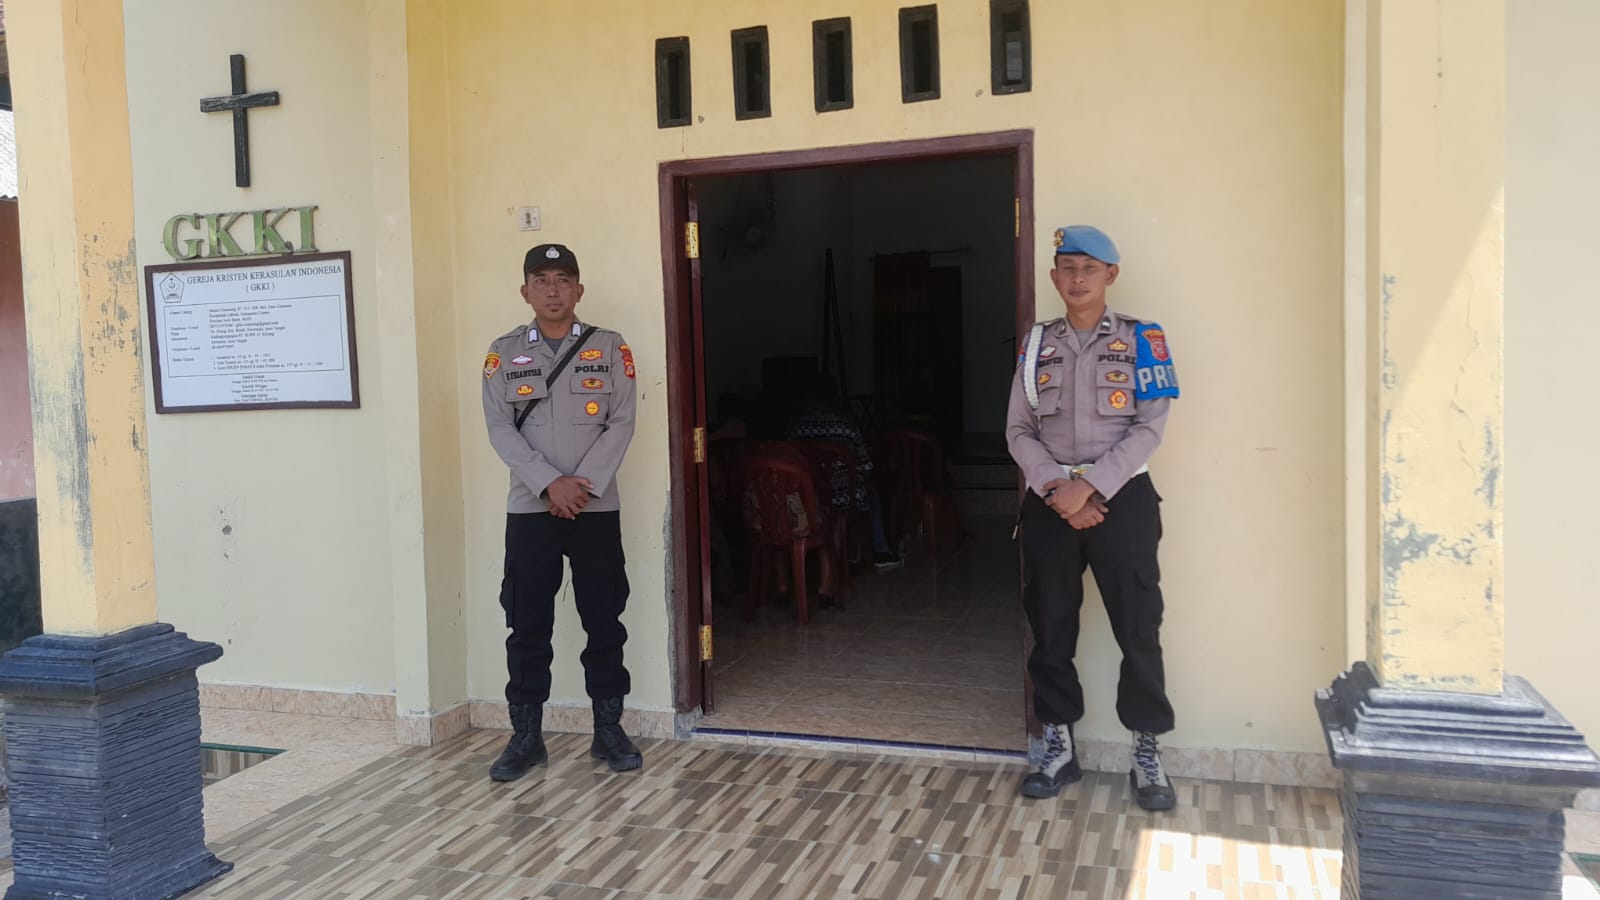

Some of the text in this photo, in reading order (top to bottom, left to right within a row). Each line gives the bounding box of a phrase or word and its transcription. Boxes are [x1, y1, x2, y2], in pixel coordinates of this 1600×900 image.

[163, 205, 319, 262] GKKI
[187, 265, 342, 285] GEREJA KRISTEN KERASULAN INDONESIA
[1097, 354, 1137, 364] POLRI
[574, 364, 609, 373] POLRI
